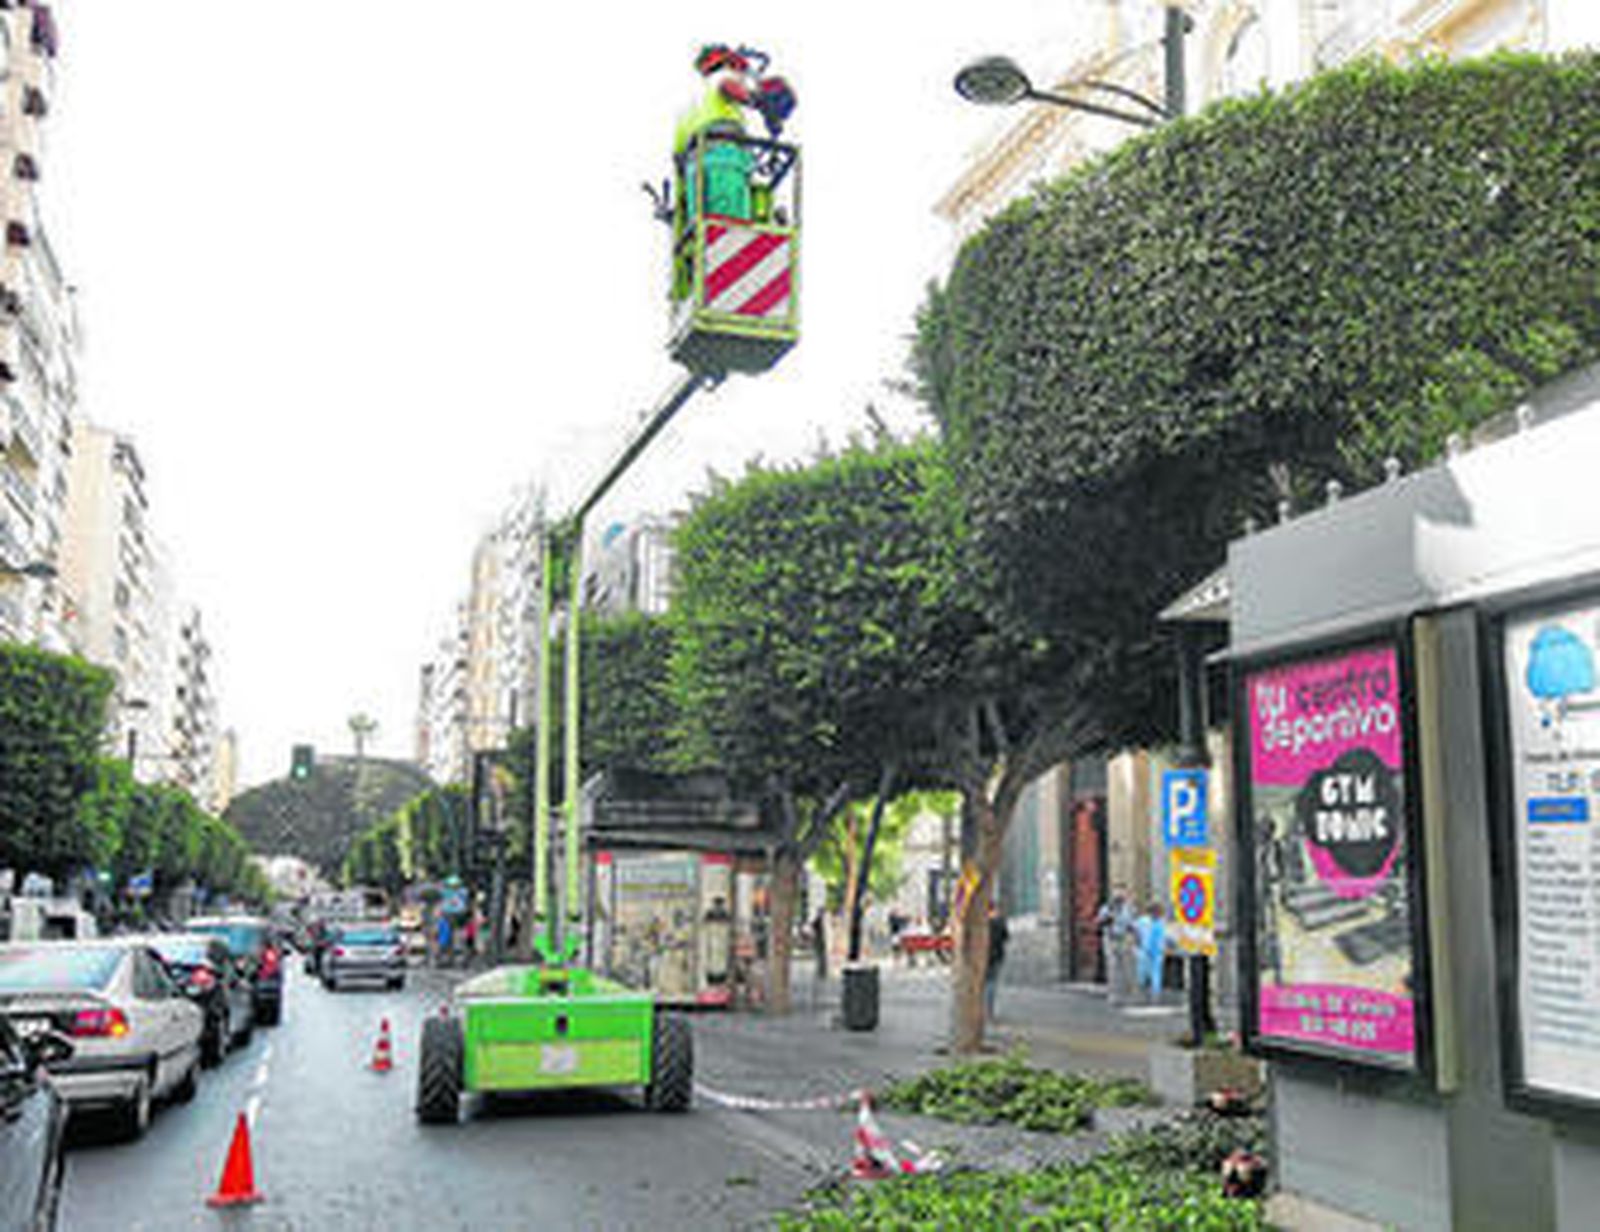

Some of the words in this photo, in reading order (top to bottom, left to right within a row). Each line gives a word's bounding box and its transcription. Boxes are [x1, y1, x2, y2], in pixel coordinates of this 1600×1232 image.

[1296, 667, 1390, 711] centro
[1263, 697, 1396, 755] deportivo
[1170, 780, 1197, 837] P
